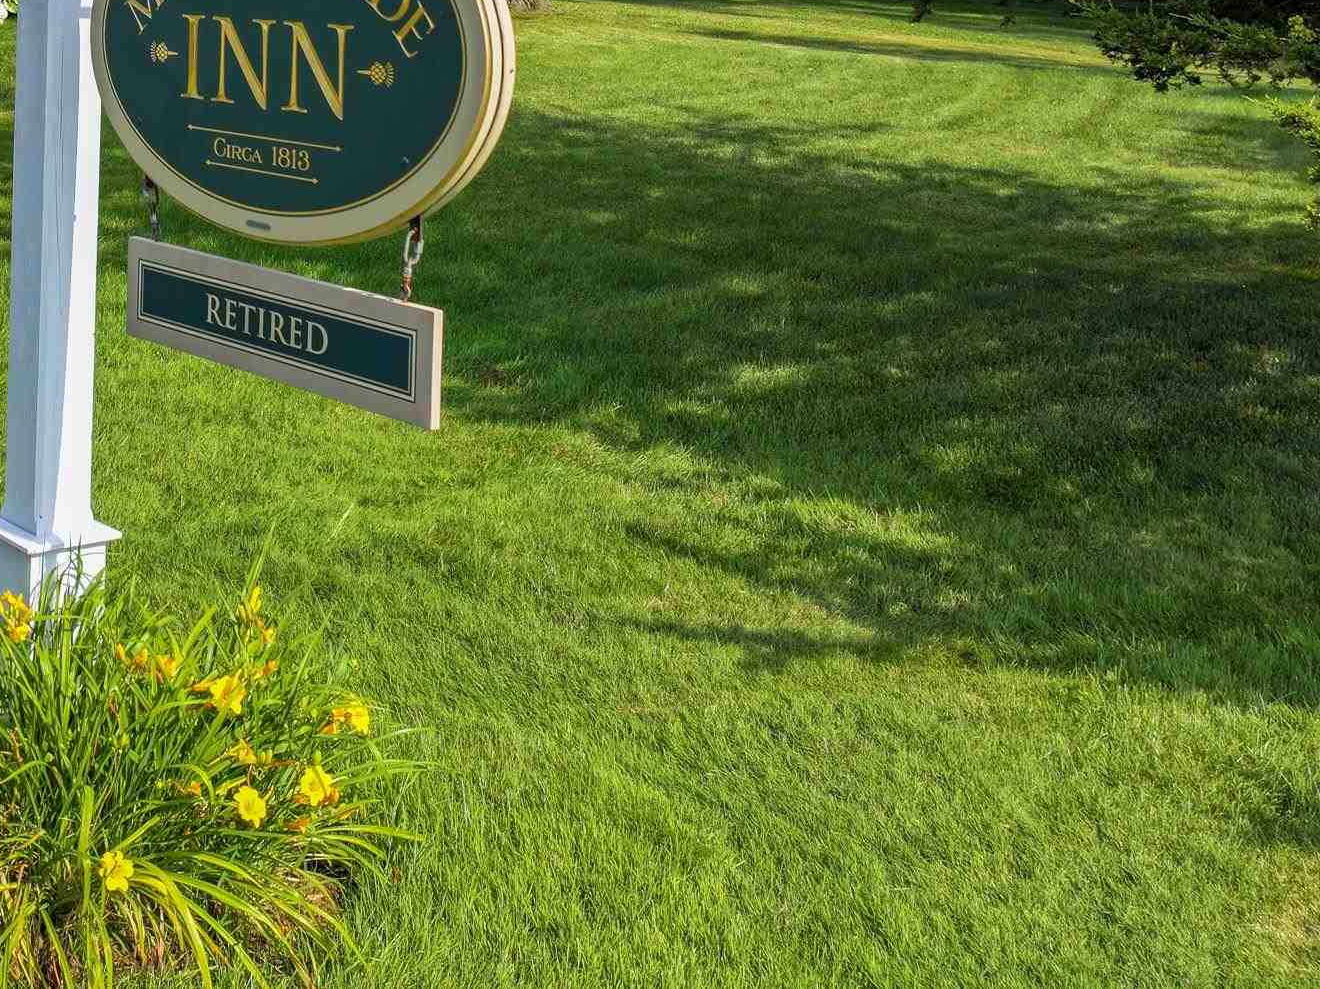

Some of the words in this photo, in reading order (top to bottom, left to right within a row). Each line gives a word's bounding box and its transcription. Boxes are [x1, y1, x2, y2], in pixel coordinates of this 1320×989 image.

[182, 14, 355, 121] INN
[271, 146, 311, 171] 1813
[206, 293, 328, 355] RETIRED
